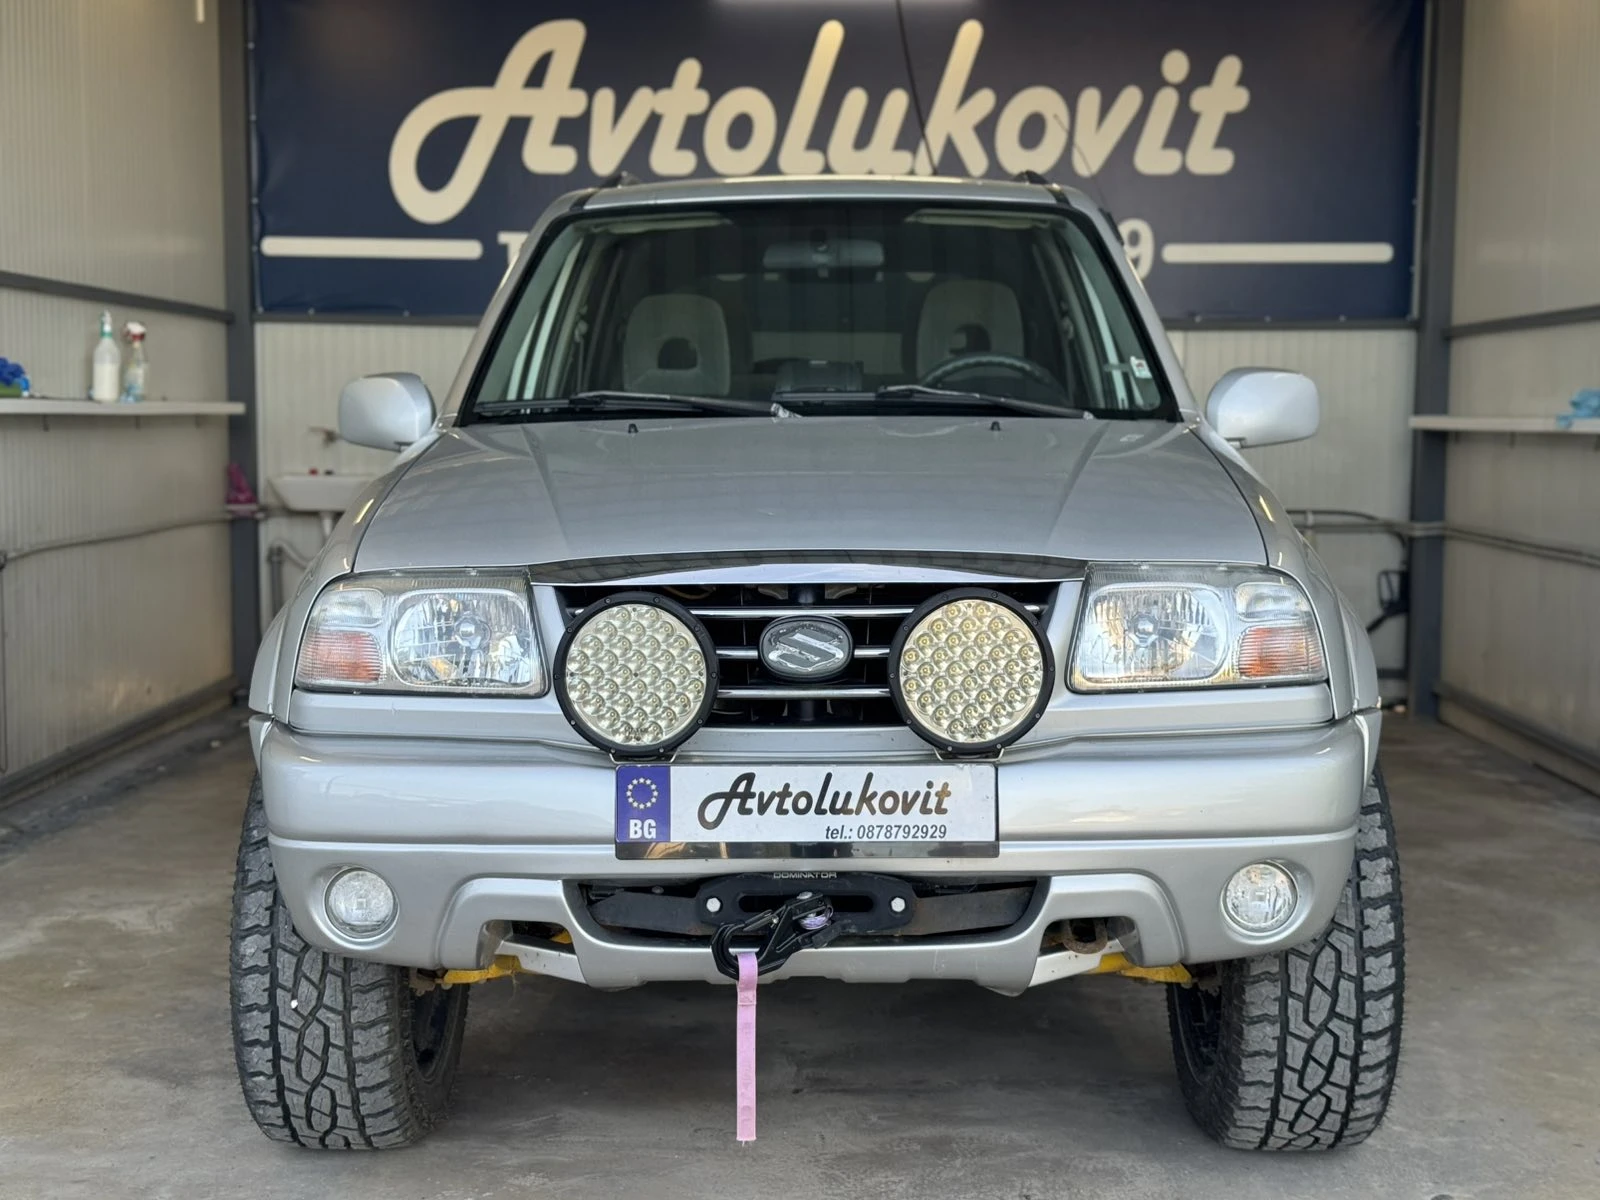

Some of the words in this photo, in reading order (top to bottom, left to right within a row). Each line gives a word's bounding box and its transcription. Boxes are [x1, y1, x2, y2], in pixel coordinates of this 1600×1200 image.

[388, 18, 1250, 224] Avtolukovit
[697, 772, 952, 830] Avtolukovit
[629, 820, 657, 840] BG
[825, 825, 853, 840] tel.:
[857, 824, 948, 840] 0878792929
